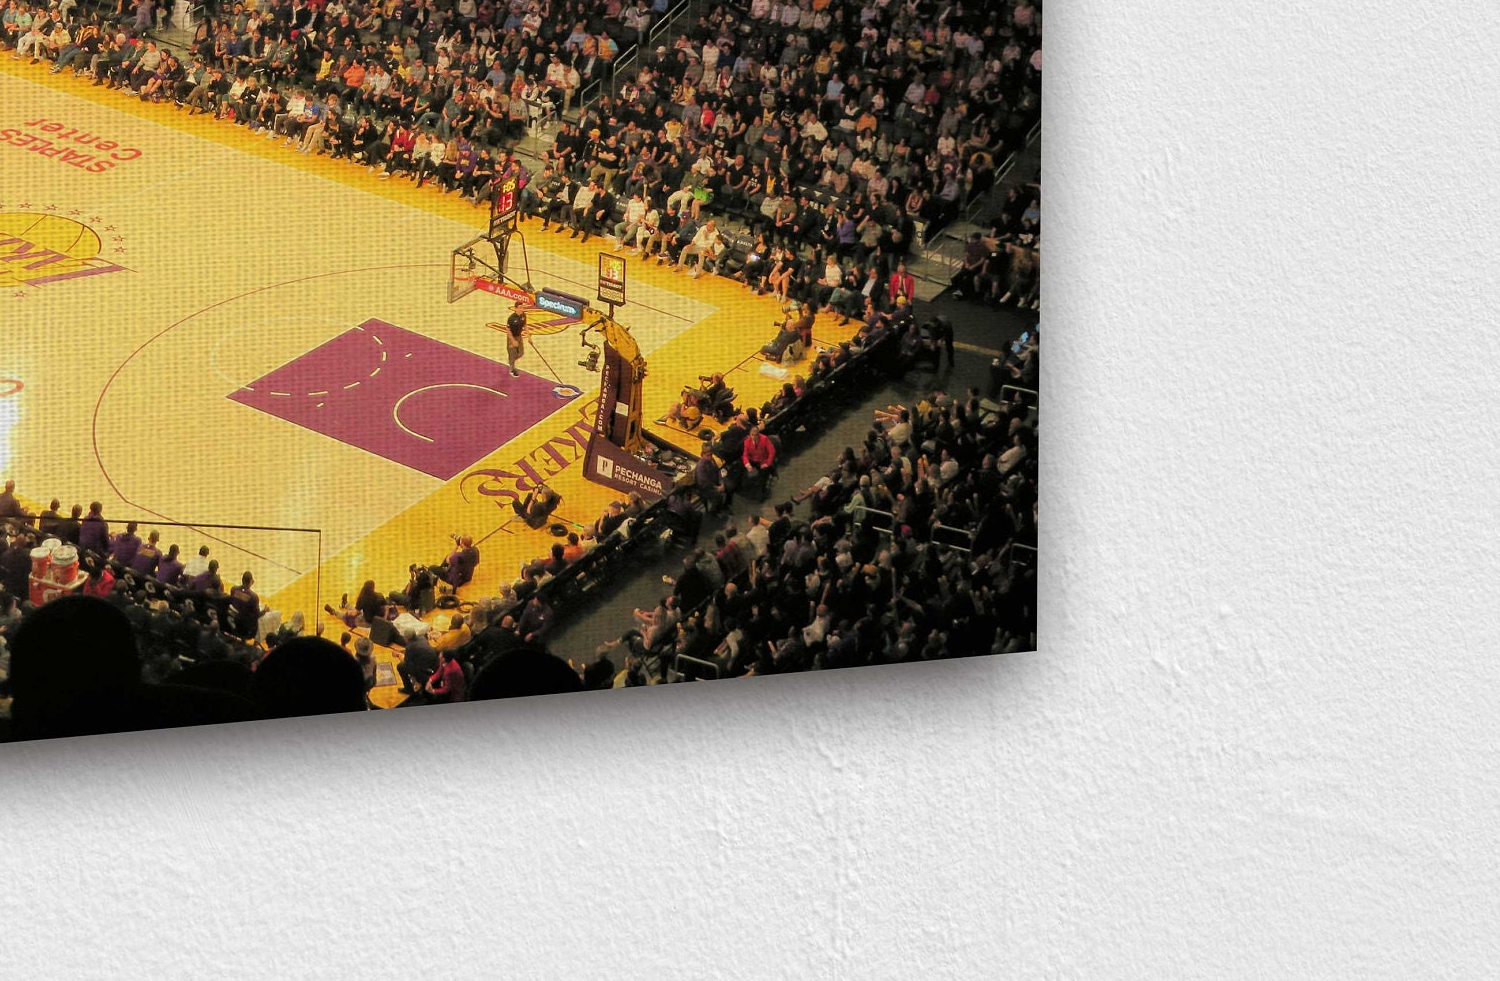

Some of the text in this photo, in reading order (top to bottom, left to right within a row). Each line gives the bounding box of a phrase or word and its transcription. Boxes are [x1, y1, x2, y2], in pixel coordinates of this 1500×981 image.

[23, 118, 143, 161] Center
[500, 191, 513, 213] 13
[495, 286, 530, 304] AAA.com
[539, 295, 576, 315] Spectrum
[614, 474, 638, 488] RESORT
[615, 465, 663, 489] PECHANGA
